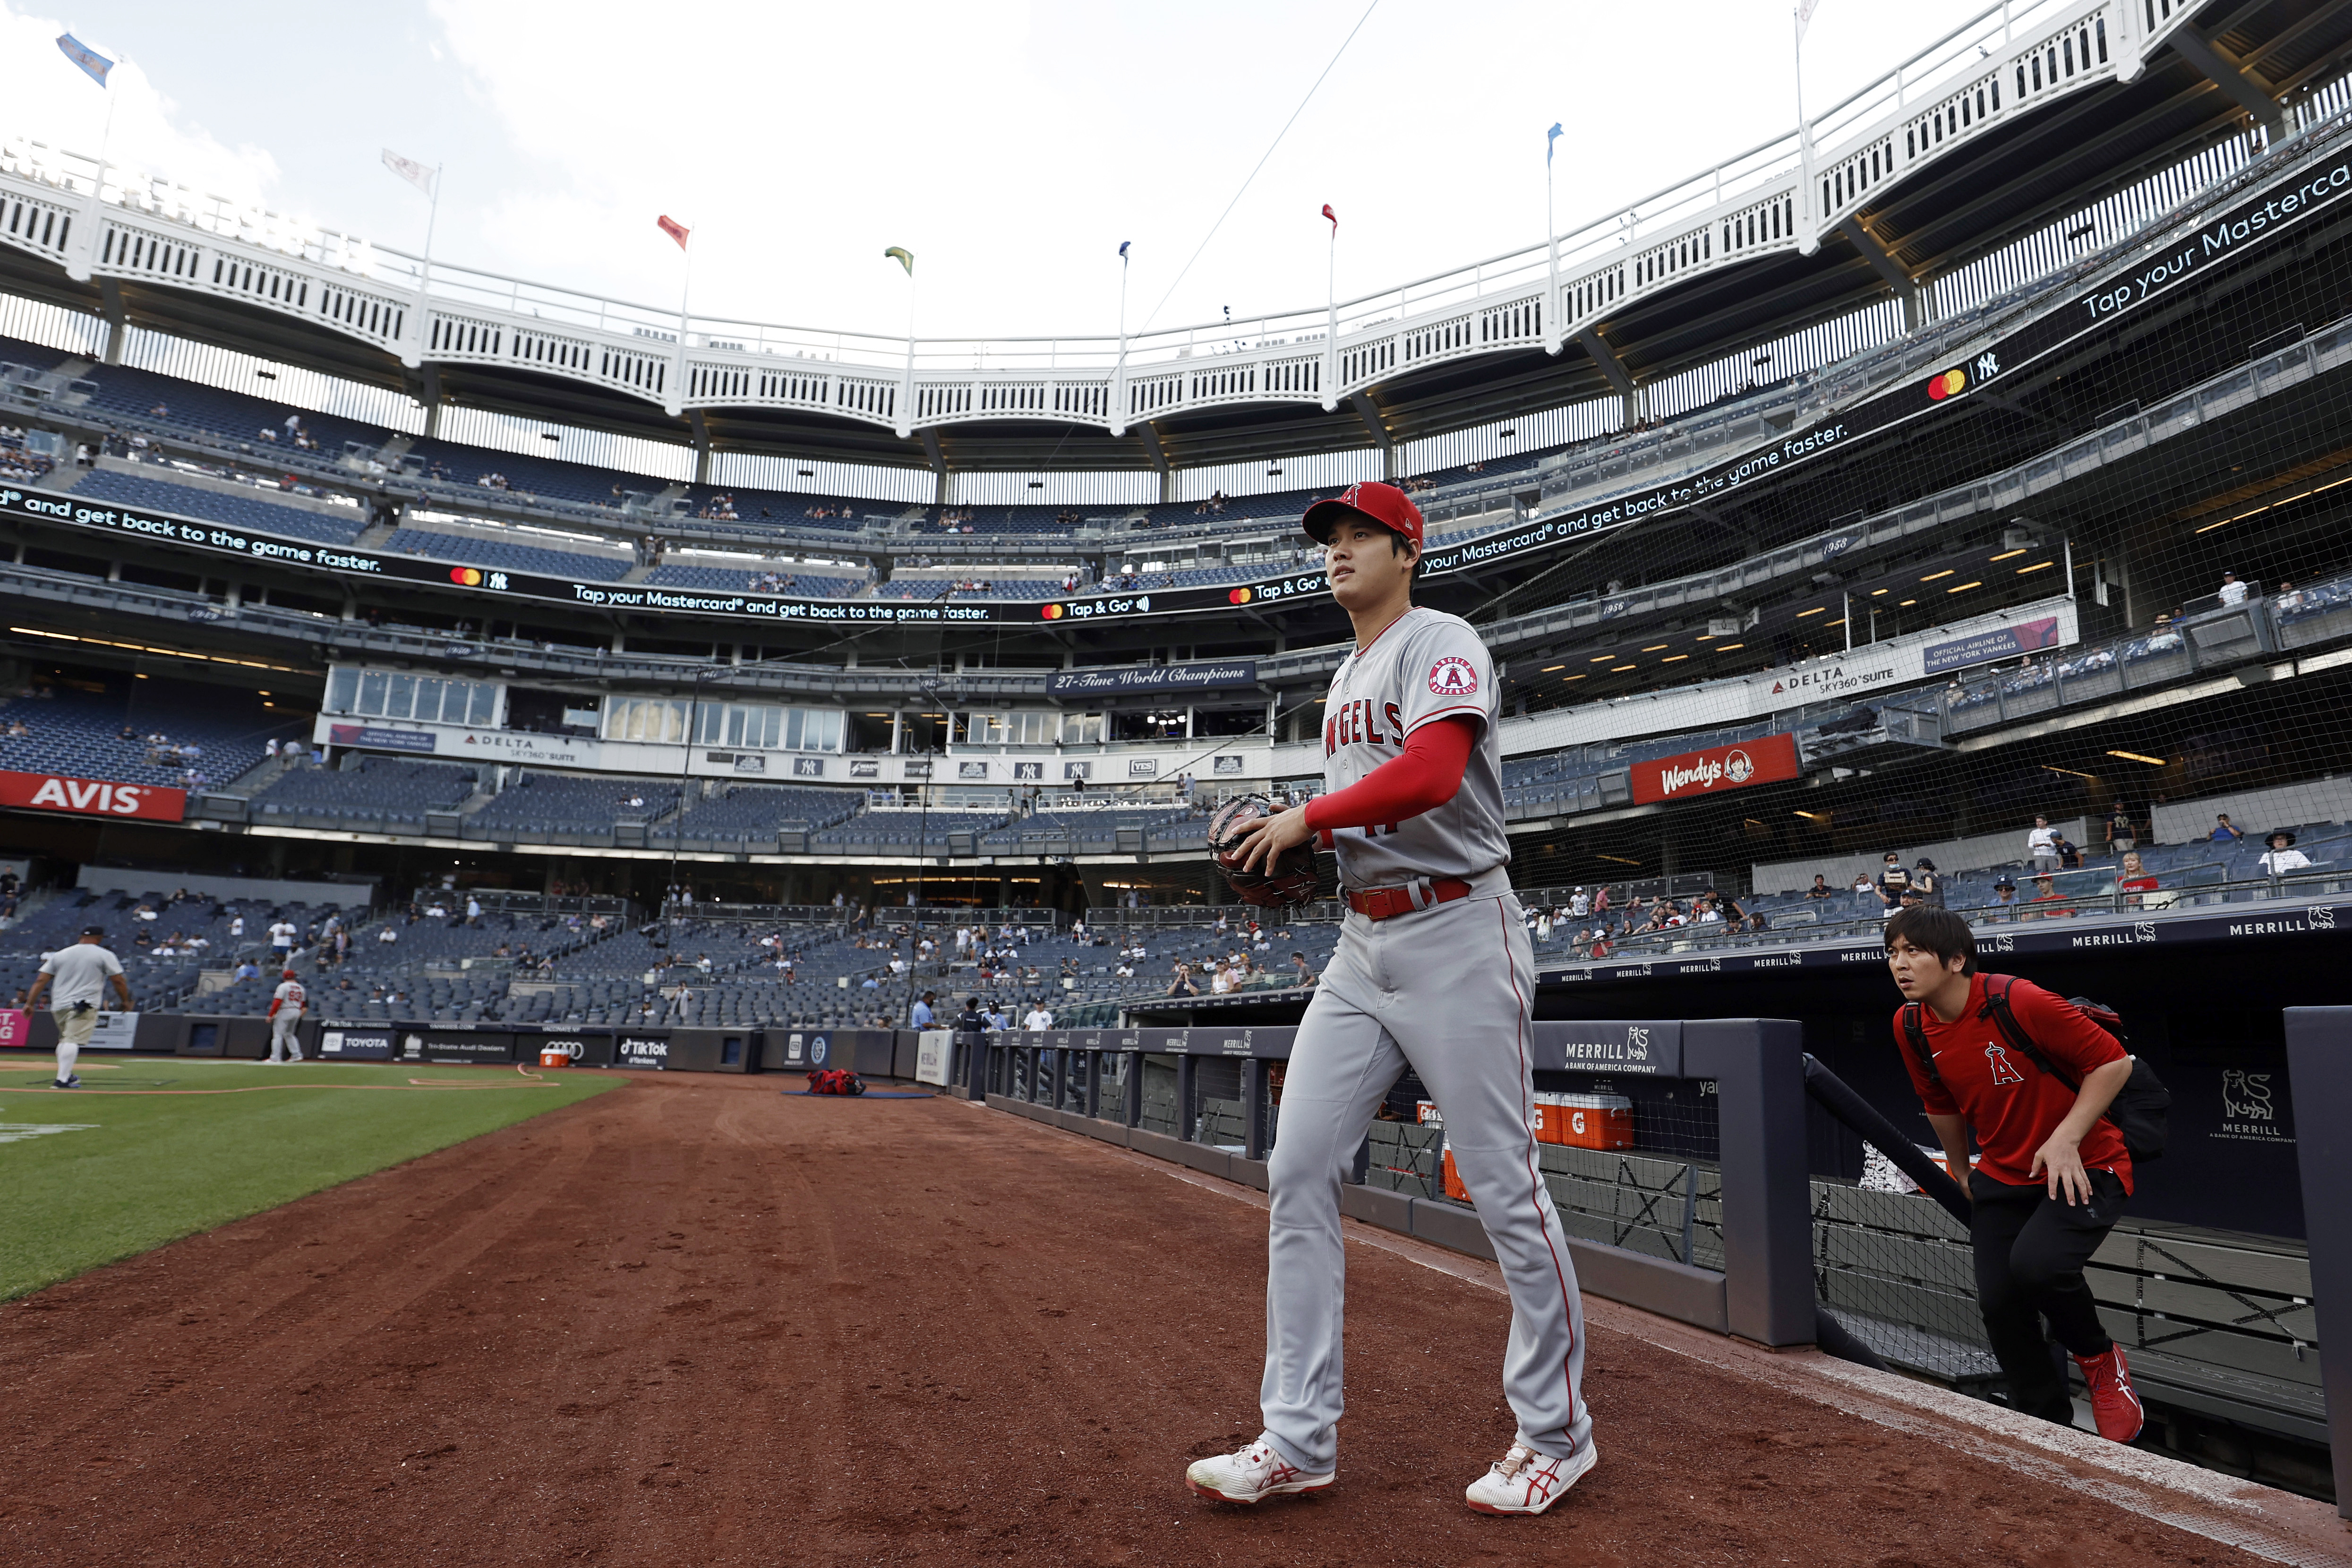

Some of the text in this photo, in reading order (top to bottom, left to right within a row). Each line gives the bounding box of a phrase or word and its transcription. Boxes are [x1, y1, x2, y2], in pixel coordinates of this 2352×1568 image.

[2083, 162, 2352, 317] Tap your Masterca
[1424, 553, 1459, 574] your
[1557, 513, 1587, 536] and
[1591, 505, 1621, 530] get
[1625, 491, 1667, 516] back
[1783, 424, 1848, 459] faster.
[24, 498, 72, 517] and
[75, 507, 117, 526] get
[121, 512, 176, 537] back
[180, 524, 205, 541] to
[209, 530, 247, 549] the
[251, 540, 312, 561] game
[316, 549, 382, 572] faster.
[1255, 585, 1282, 600] Tap
[1283, 581, 1294, 595] &
[573, 584, 605, 604] Tap
[607, 591, 644, 606] your
[746, 600, 777, 614] and
[778, 603, 807, 618] get
[810, 603, 847, 619] back
[848, 605, 866, 619] to
[868, 605, 894, 619] the
[896, 608, 939, 621] game
[1067, 602, 1093, 618] Tap
[1095, 600, 1106, 615] &
[1933, 634, 2008, 657] OFFICIAL AIRLINE OF
[1926, 641, 2016, 668] THE NEW YORK YANKEES
[1435, 658, 1471, 669] ANGELS
[1054, 664, 1247, 689] 27-Time World Champions
[1430, 676, 1437, 684] 19
[1789, 667, 1843, 689] DELTA
[1862, 668, 1894, 684] SUITE
[1321, 697, 1403, 763] NGELS
[482, 736, 533, 749] DELTA
[549, 752, 576, 762] SUITE
[1135, 762, 1152, 770] YES
[1661, 757, 1722, 795] Wendy's
[2230, 920, 2306, 936] MERRILL
[2072, 933, 2133, 947] MERRILL
[1754, 958, 1789, 968] MERRILL
[1842, 950, 1882, 962] MERRILL
[1616, 968, 1642, 978] MERRILL
[1680, 964, 1710, 974] MERRILL
[1561, 974, 1584, 982] MERRILL
[345, 1037, 389, 1048] TOYOTA
[632, 1041, 668, 1056] TikTok
[1223, 1039, 1243, 1049] MERRILL
[1565, 1043, 1624, 1060] MERRILL
[1595, 1063, 1622, 1072] AMERICA
[1623, 1064, 1656, 1073] COMPANY
[1572, 1112, 1584, 1134] G
[2223, 1123, 2281, 1135] MERRILL
